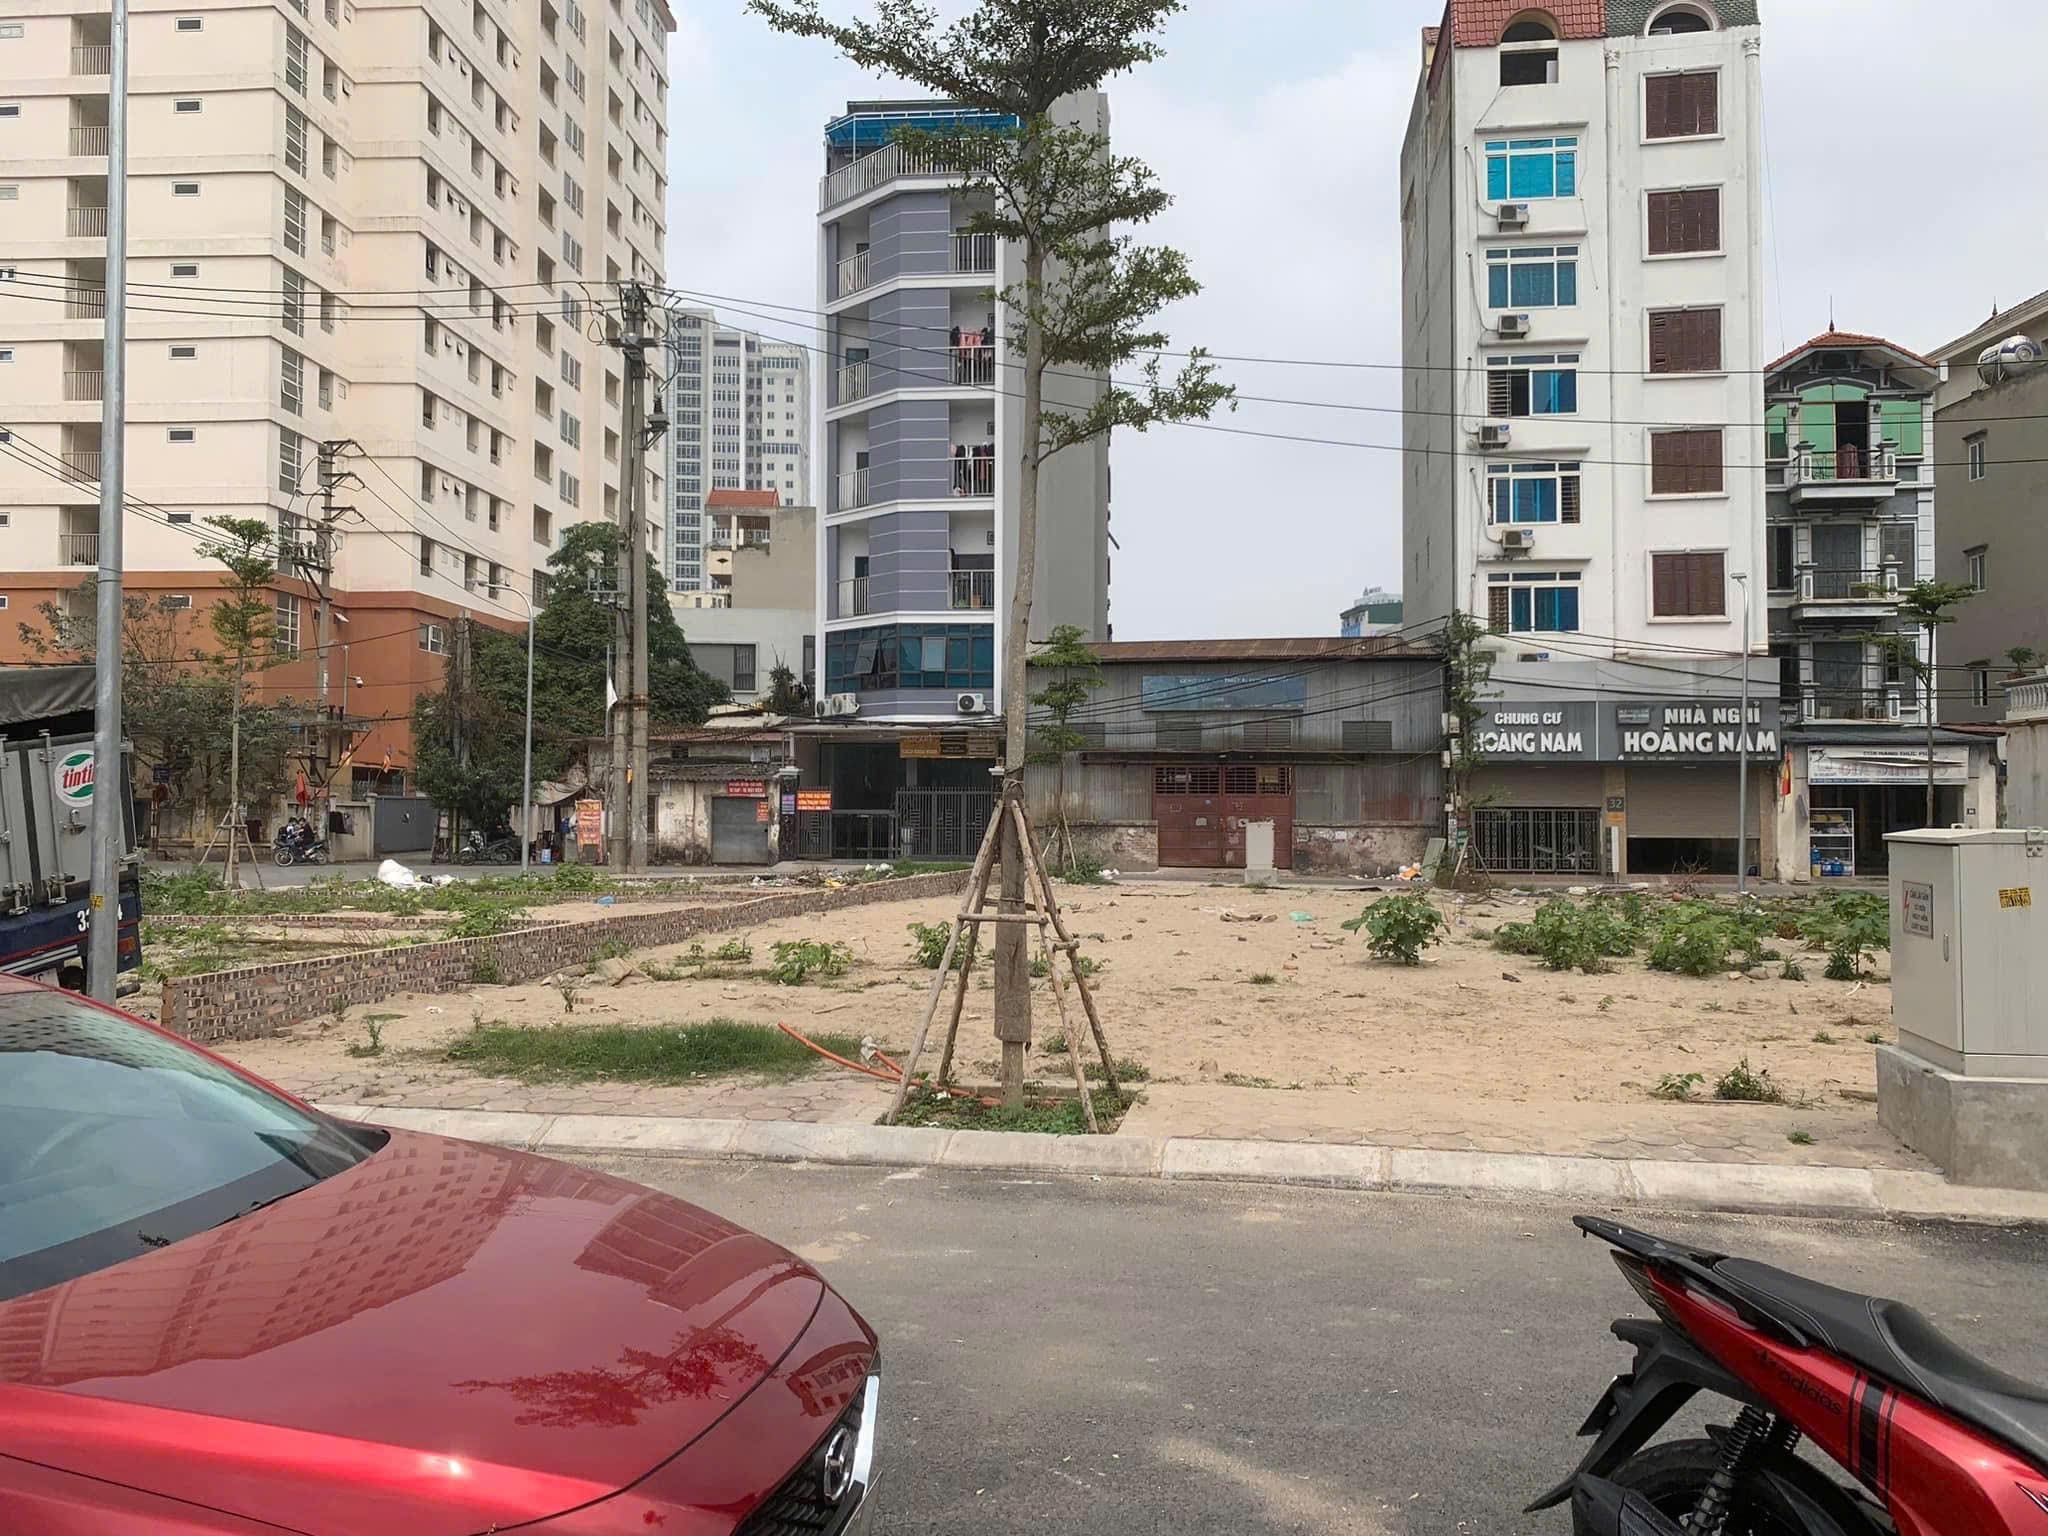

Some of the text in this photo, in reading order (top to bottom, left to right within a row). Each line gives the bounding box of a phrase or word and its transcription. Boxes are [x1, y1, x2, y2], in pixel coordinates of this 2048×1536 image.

[1494, 711, 1563, 725] CHUNG CƯ
[1664, 703, 1706, 725] NHÀ
[1540, 732, 1583, 753] NAM
[1624, 726, 1777, 753] HOÀNG NAM
[1609, 799, 1622, 809] 32
[1777, 1369, 1842, 1416] adidas
